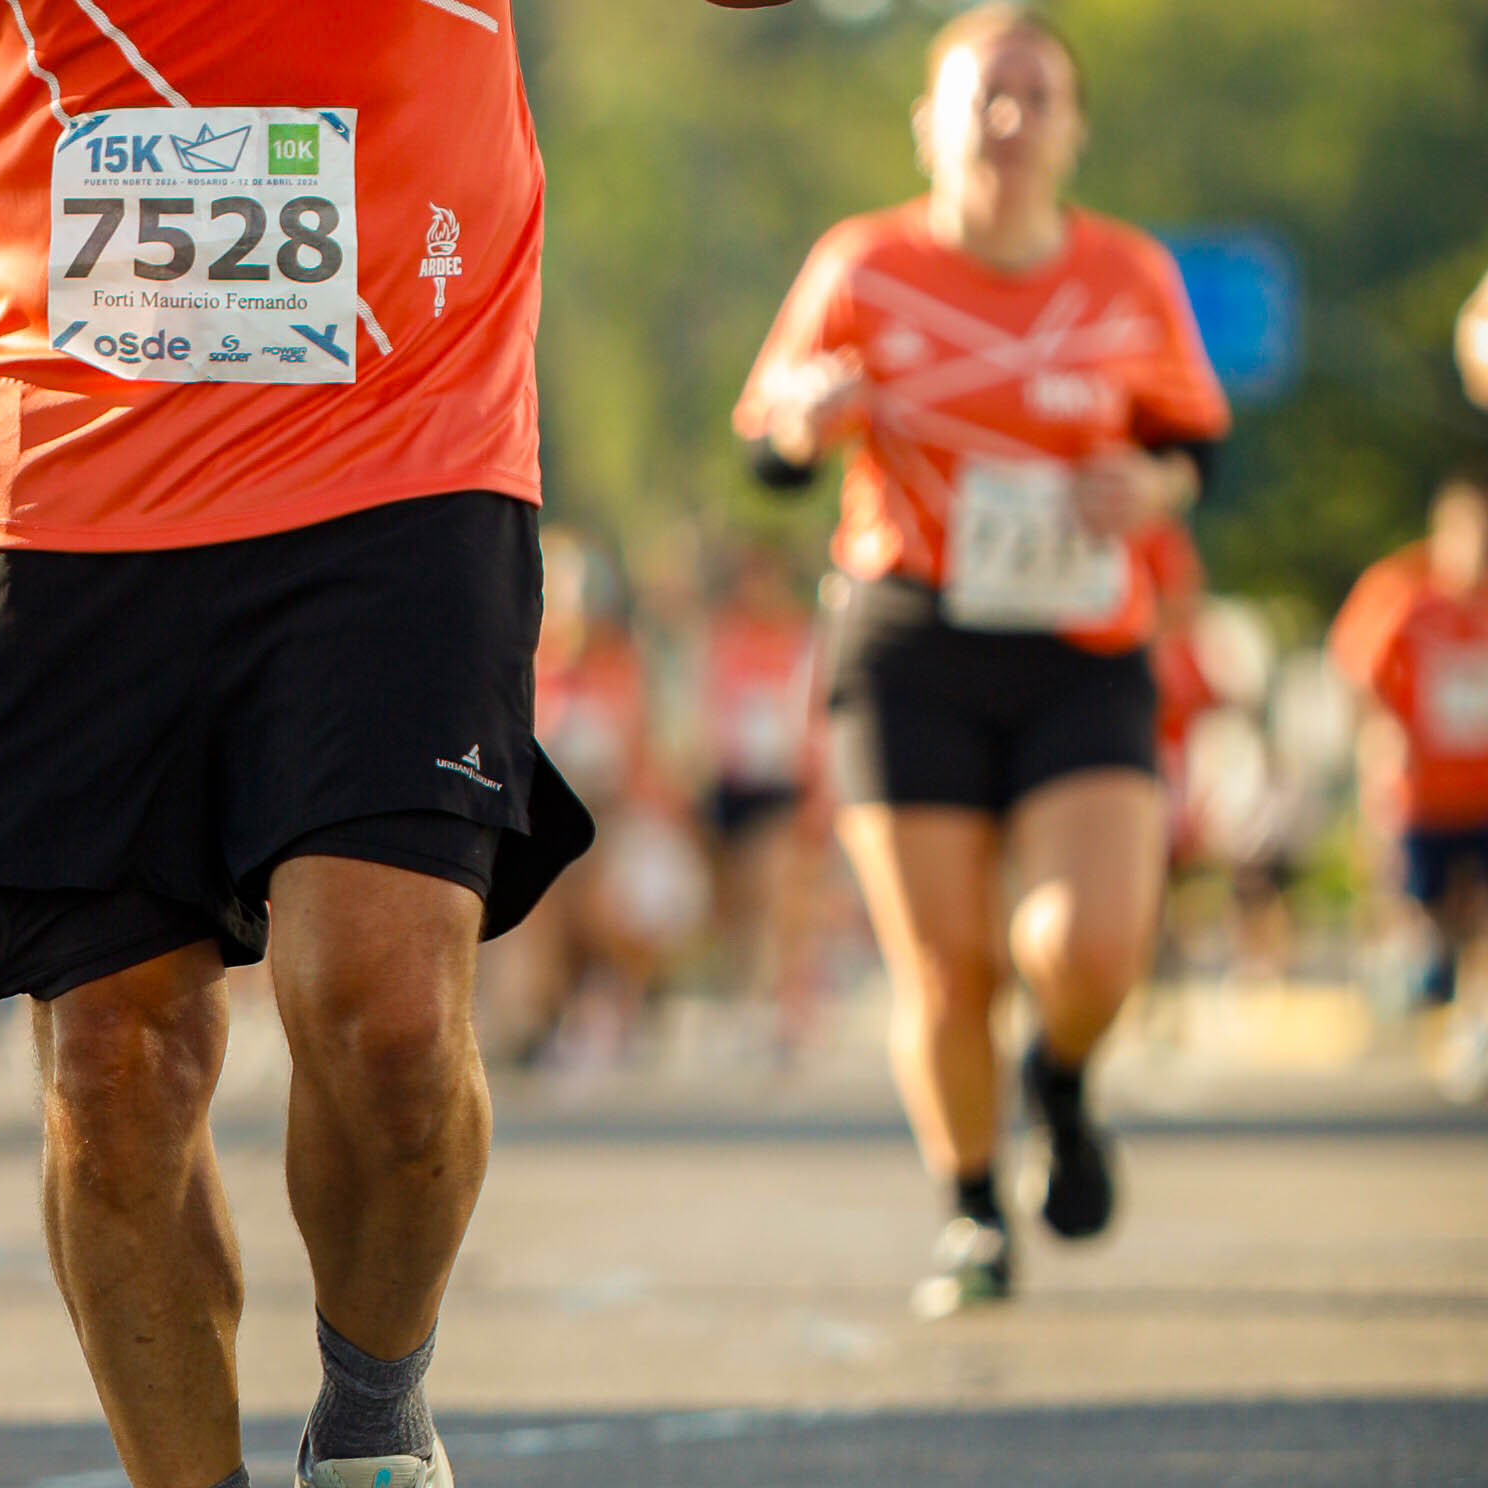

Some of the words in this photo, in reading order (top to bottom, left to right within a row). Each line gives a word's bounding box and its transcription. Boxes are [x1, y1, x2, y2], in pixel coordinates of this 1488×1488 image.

[86, 135, 164, 172] 15K
[273, 139, 315, 161] 10K
[84, 178, 120, 186] PUERTO
[122, 178, 152, 186] NORTE
[187, 178, 228, 186] ROSARIO
[253, 178, 263, 186] DE
[266, 178, 293, 186] ABRIL
[63, 195, 343, 284] 7528
[418, 256, 463, 278] ARDEC
[92, 289, 134, 308] Forti
[139, 291, 221, 309] Mauricio
[226, 292, 308, 310] Fernando
[94, 328, 192, 363] osde
[262, 346, 308, 355] POWER
